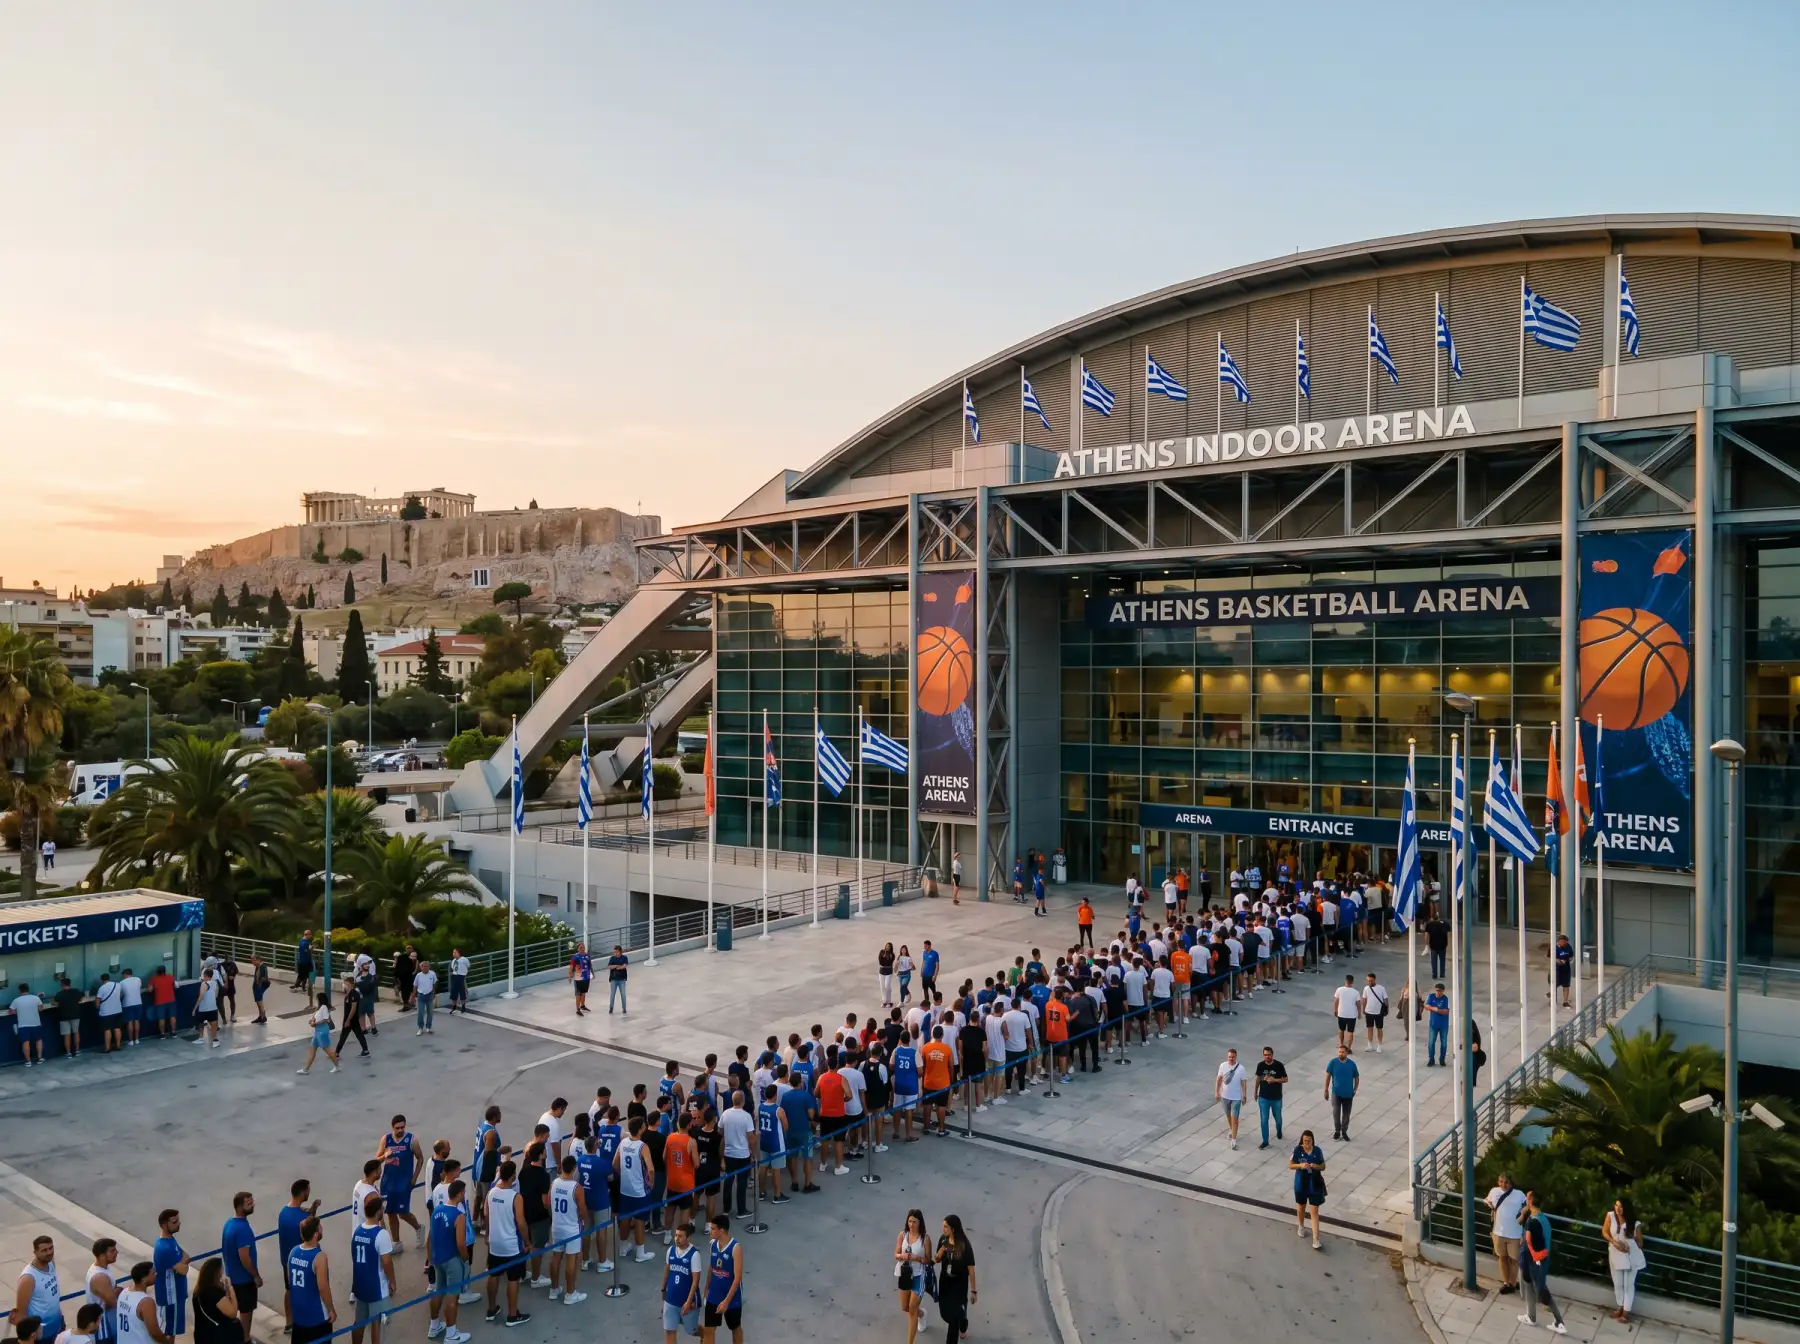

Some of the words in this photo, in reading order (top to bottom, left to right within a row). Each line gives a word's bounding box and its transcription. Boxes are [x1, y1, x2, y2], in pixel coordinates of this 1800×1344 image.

[1054, 439, 1176, 479] ATHENS
[1185, 422, 1327, 465] INDOOR
[1335, 404, 1476, 448] ARENA
[1109, 597, 1210, 622] ATHENS
[1218, 590, 1405, 620] BASKETBALL
[1413, 585, 1530, 613] ARENA
[922, 775, 969, 789] ATHENS
[925, 789, 966, 803] ARENA
[1175, 813, 1212, 825] ARENA
[1269, 817, 1354, 836] ENTRANCE
[1593, 830, 1675, 854] ARENA
[114, 913, 159, 934] INFO
[0, 923, 79, 948] TICKETS
[760, 1118, 772, 1132] 11
[624, 1156, 632, 1169] 9
[555, 1197, 568, 1213] 10
[356, 1245, 366, 1263] 11
[291, 1268, 305, 1288] 13
